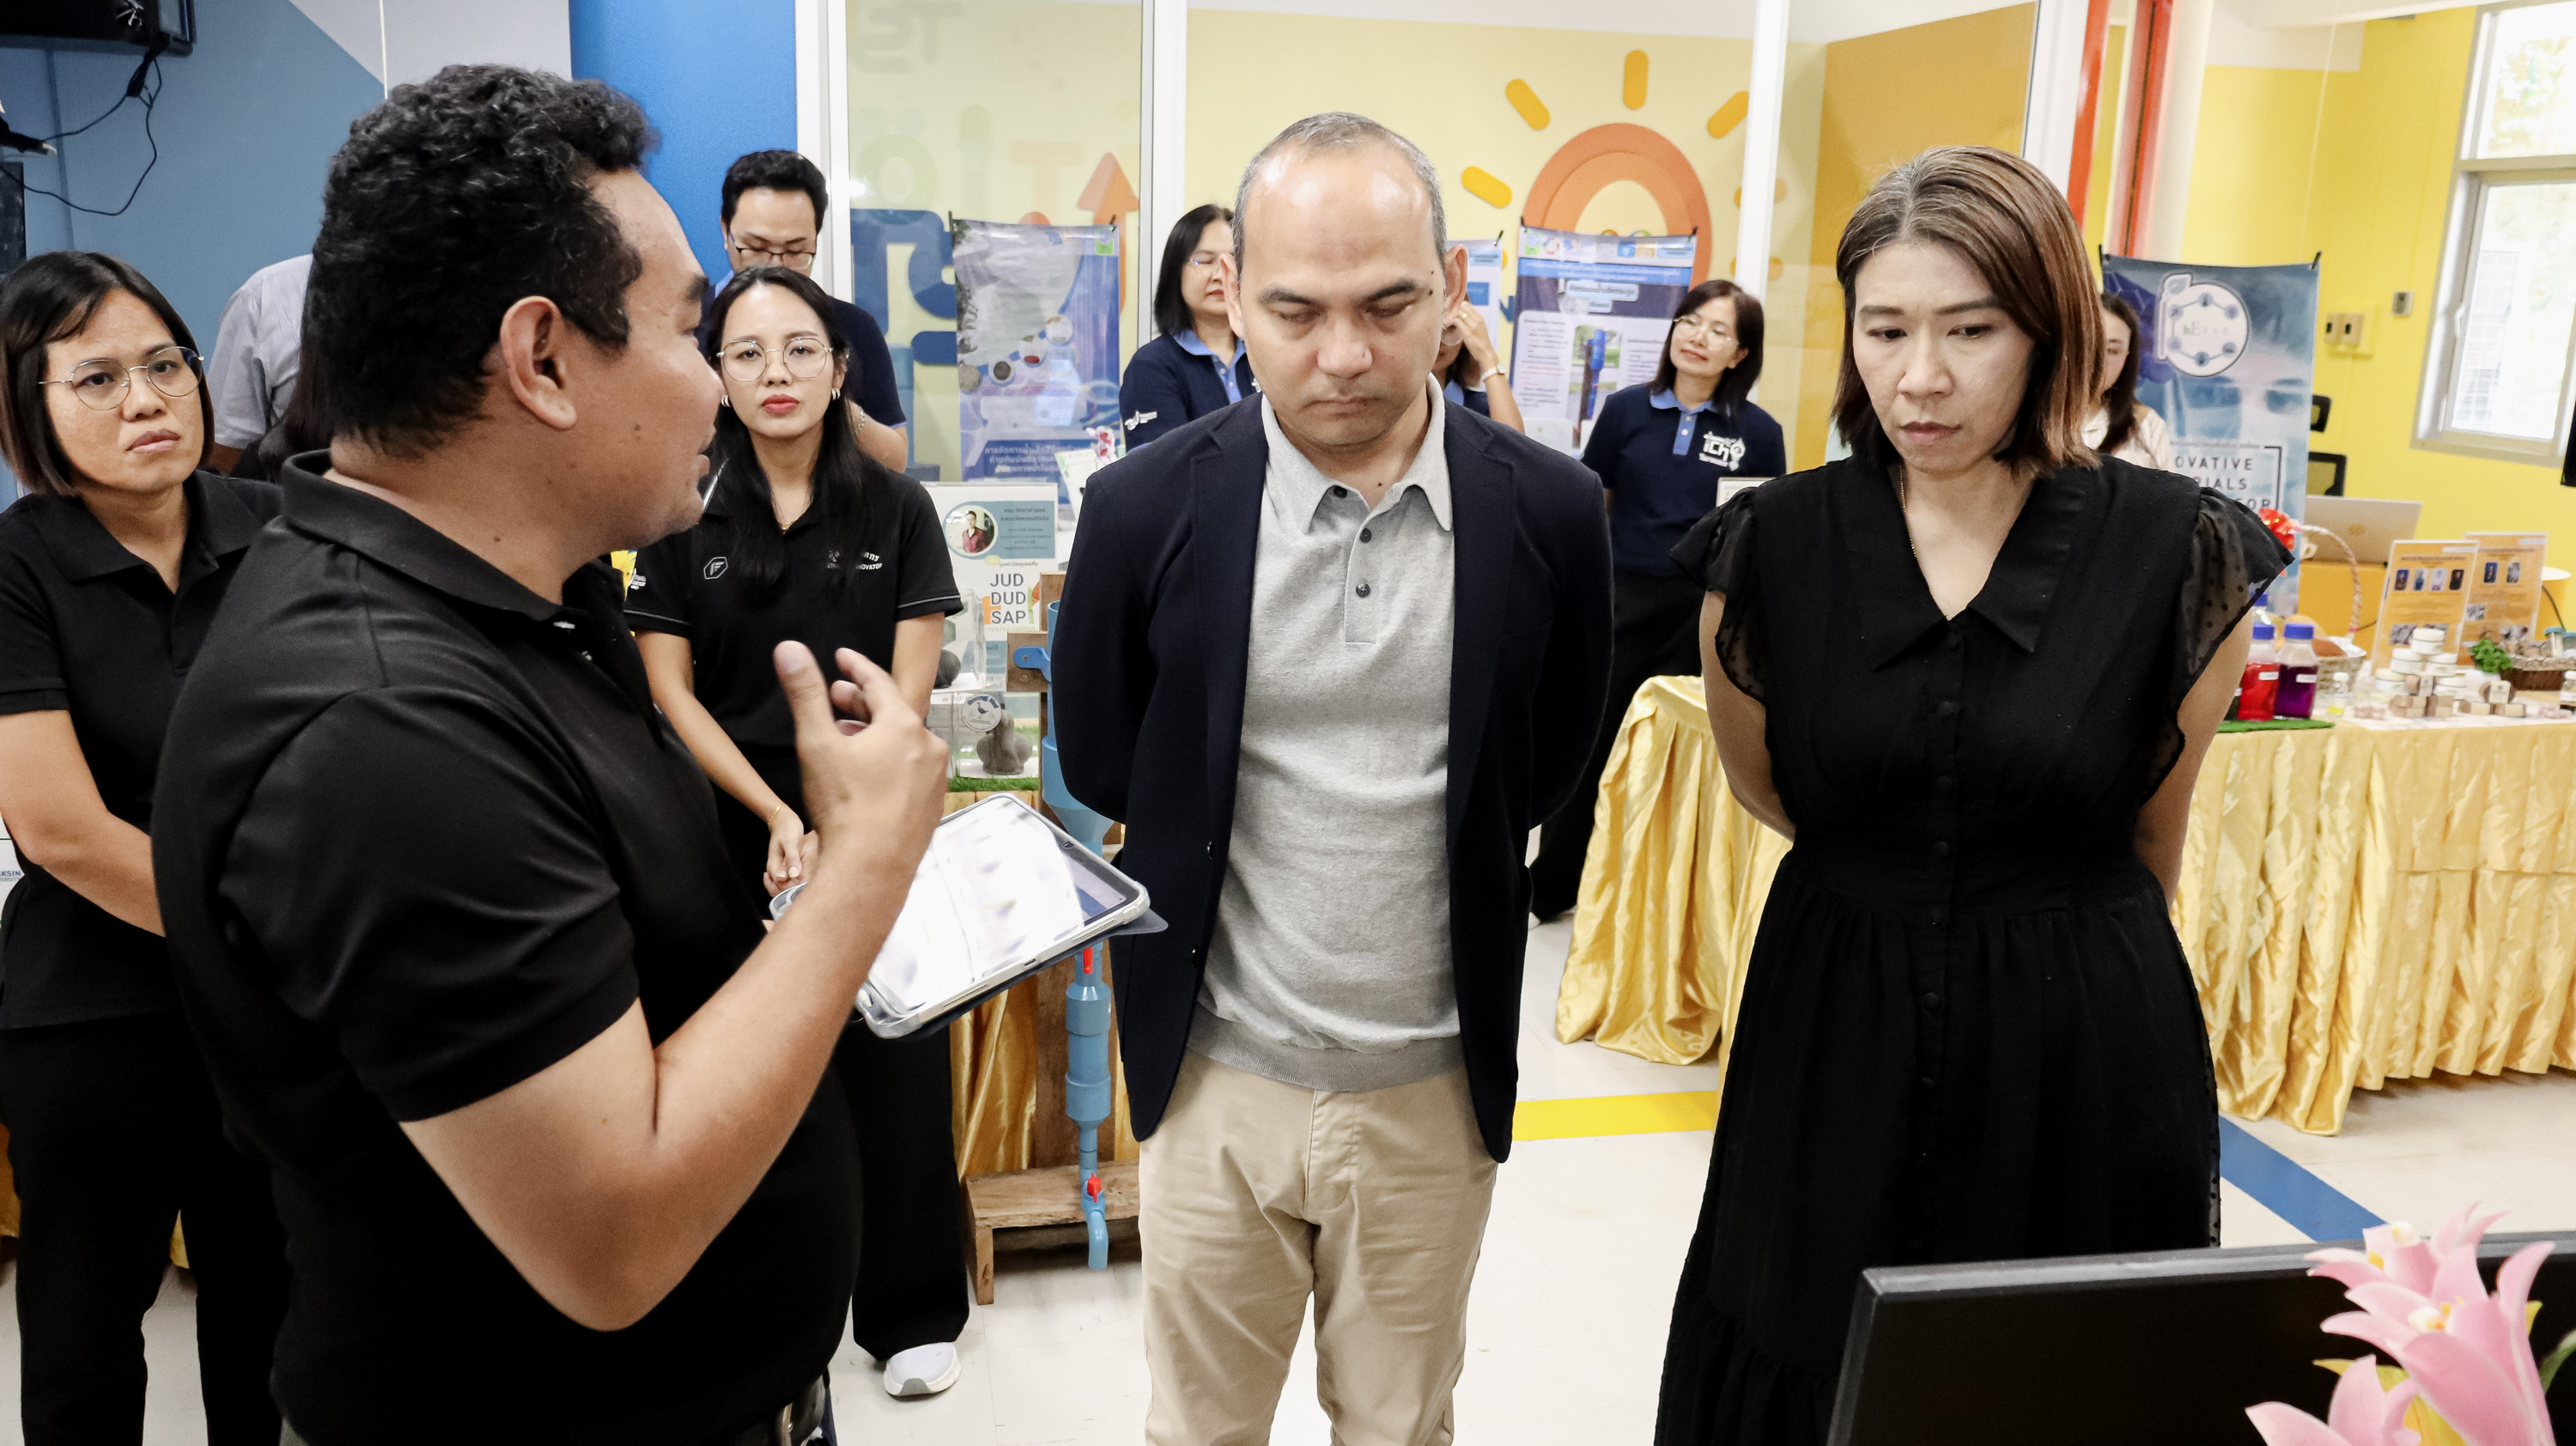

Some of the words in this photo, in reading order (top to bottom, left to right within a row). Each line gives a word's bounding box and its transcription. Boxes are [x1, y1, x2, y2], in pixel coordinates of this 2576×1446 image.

[2175, 456, 2253, 471] OVATIVE
[2194, 477, 2248, 490] RIALS
[989, 573, 1024, 587] JUD
[991, 592, 1026, 605] DUD
[991, 611, 1026, 624] SAP
